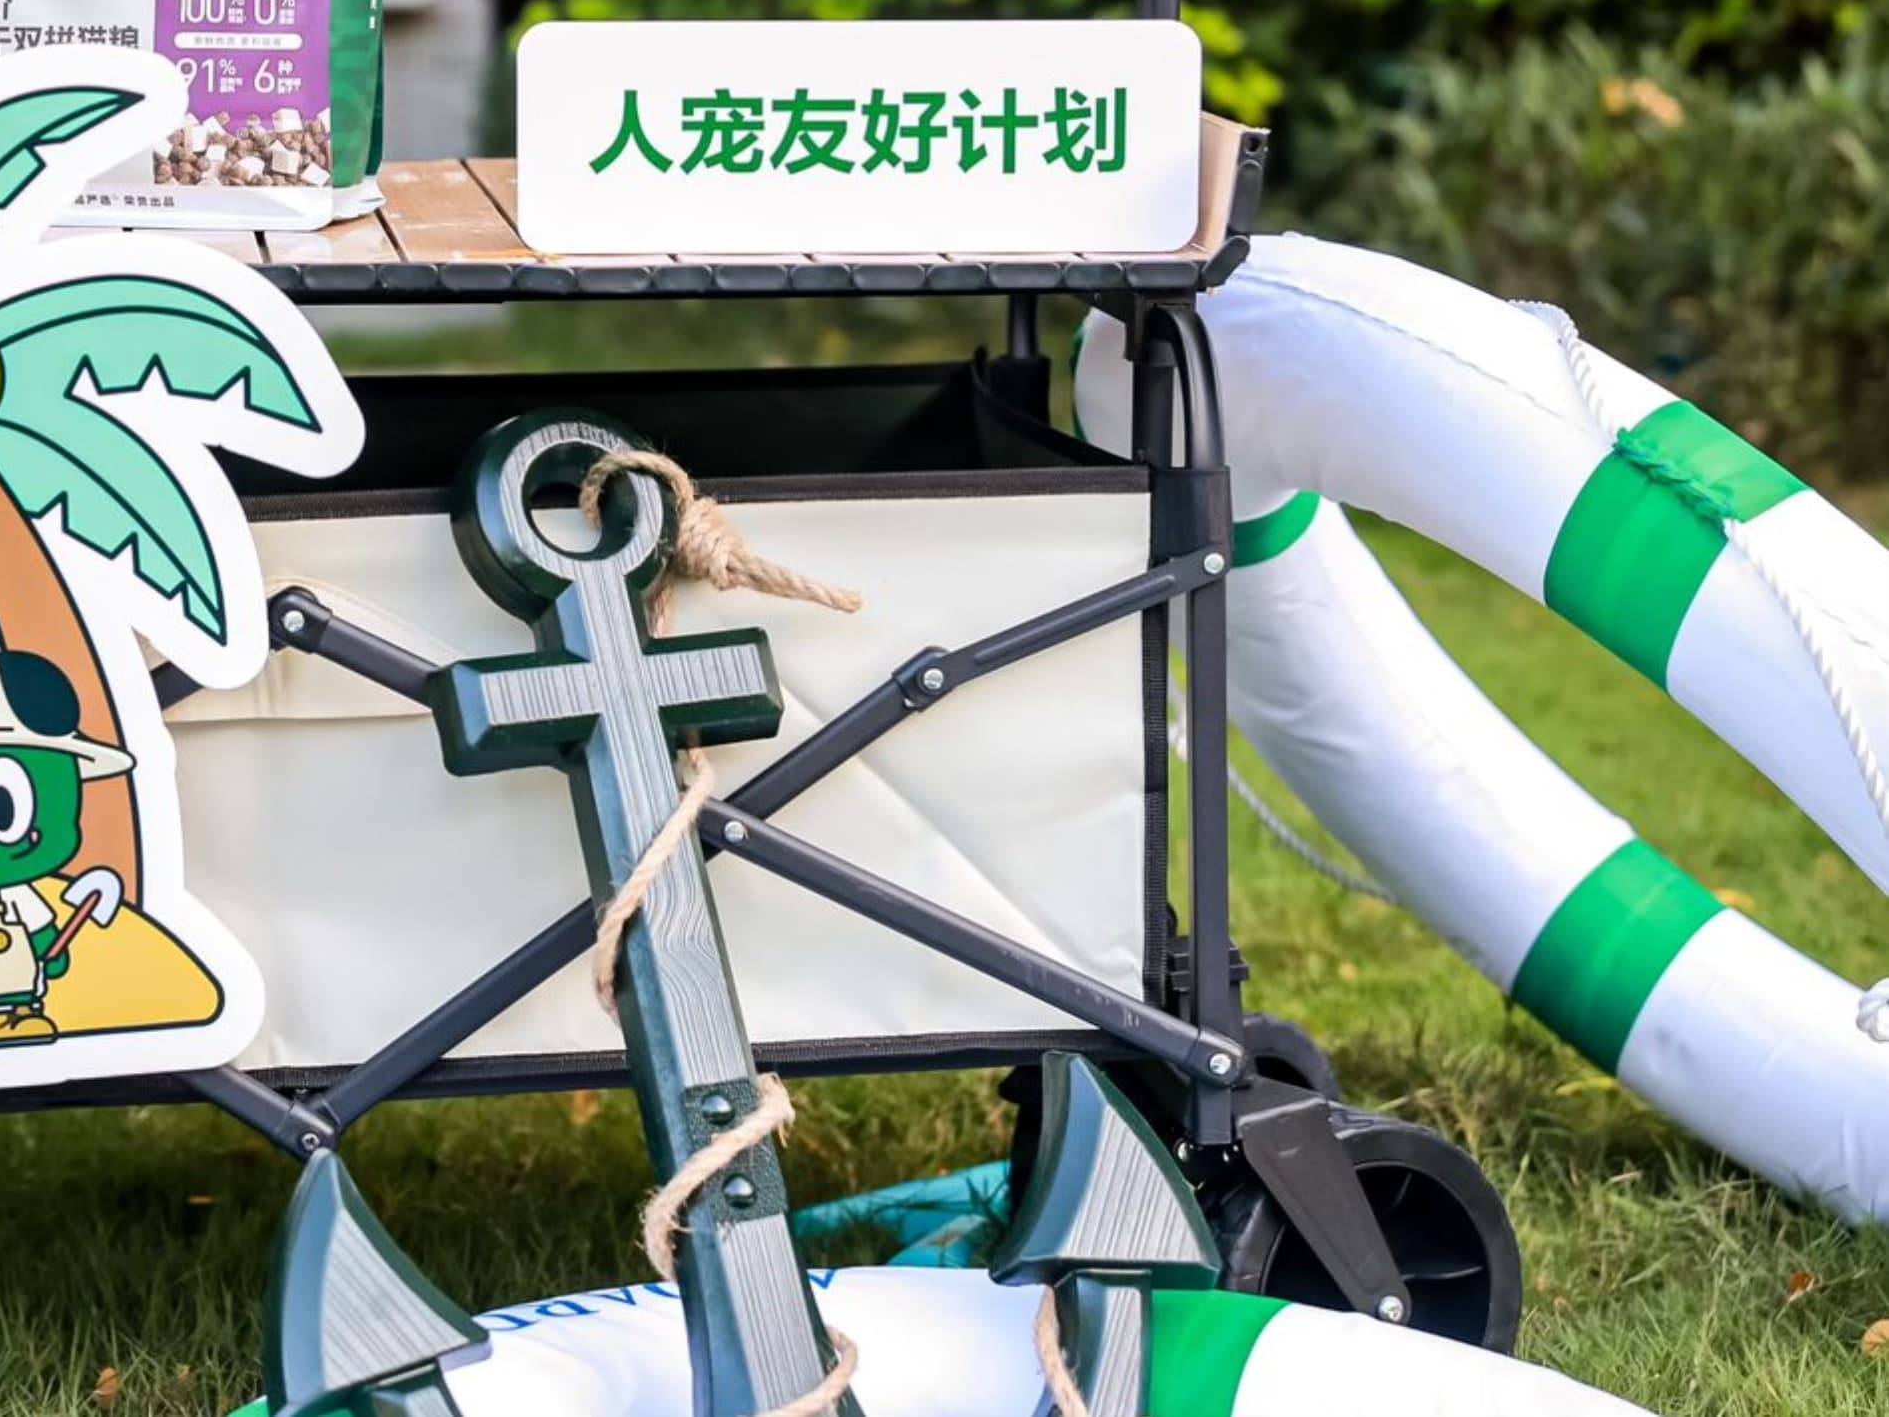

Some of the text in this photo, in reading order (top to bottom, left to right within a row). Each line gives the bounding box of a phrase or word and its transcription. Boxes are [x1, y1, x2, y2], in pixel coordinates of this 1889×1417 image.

[588, 86, 1128, 175] 人宠友好计划
